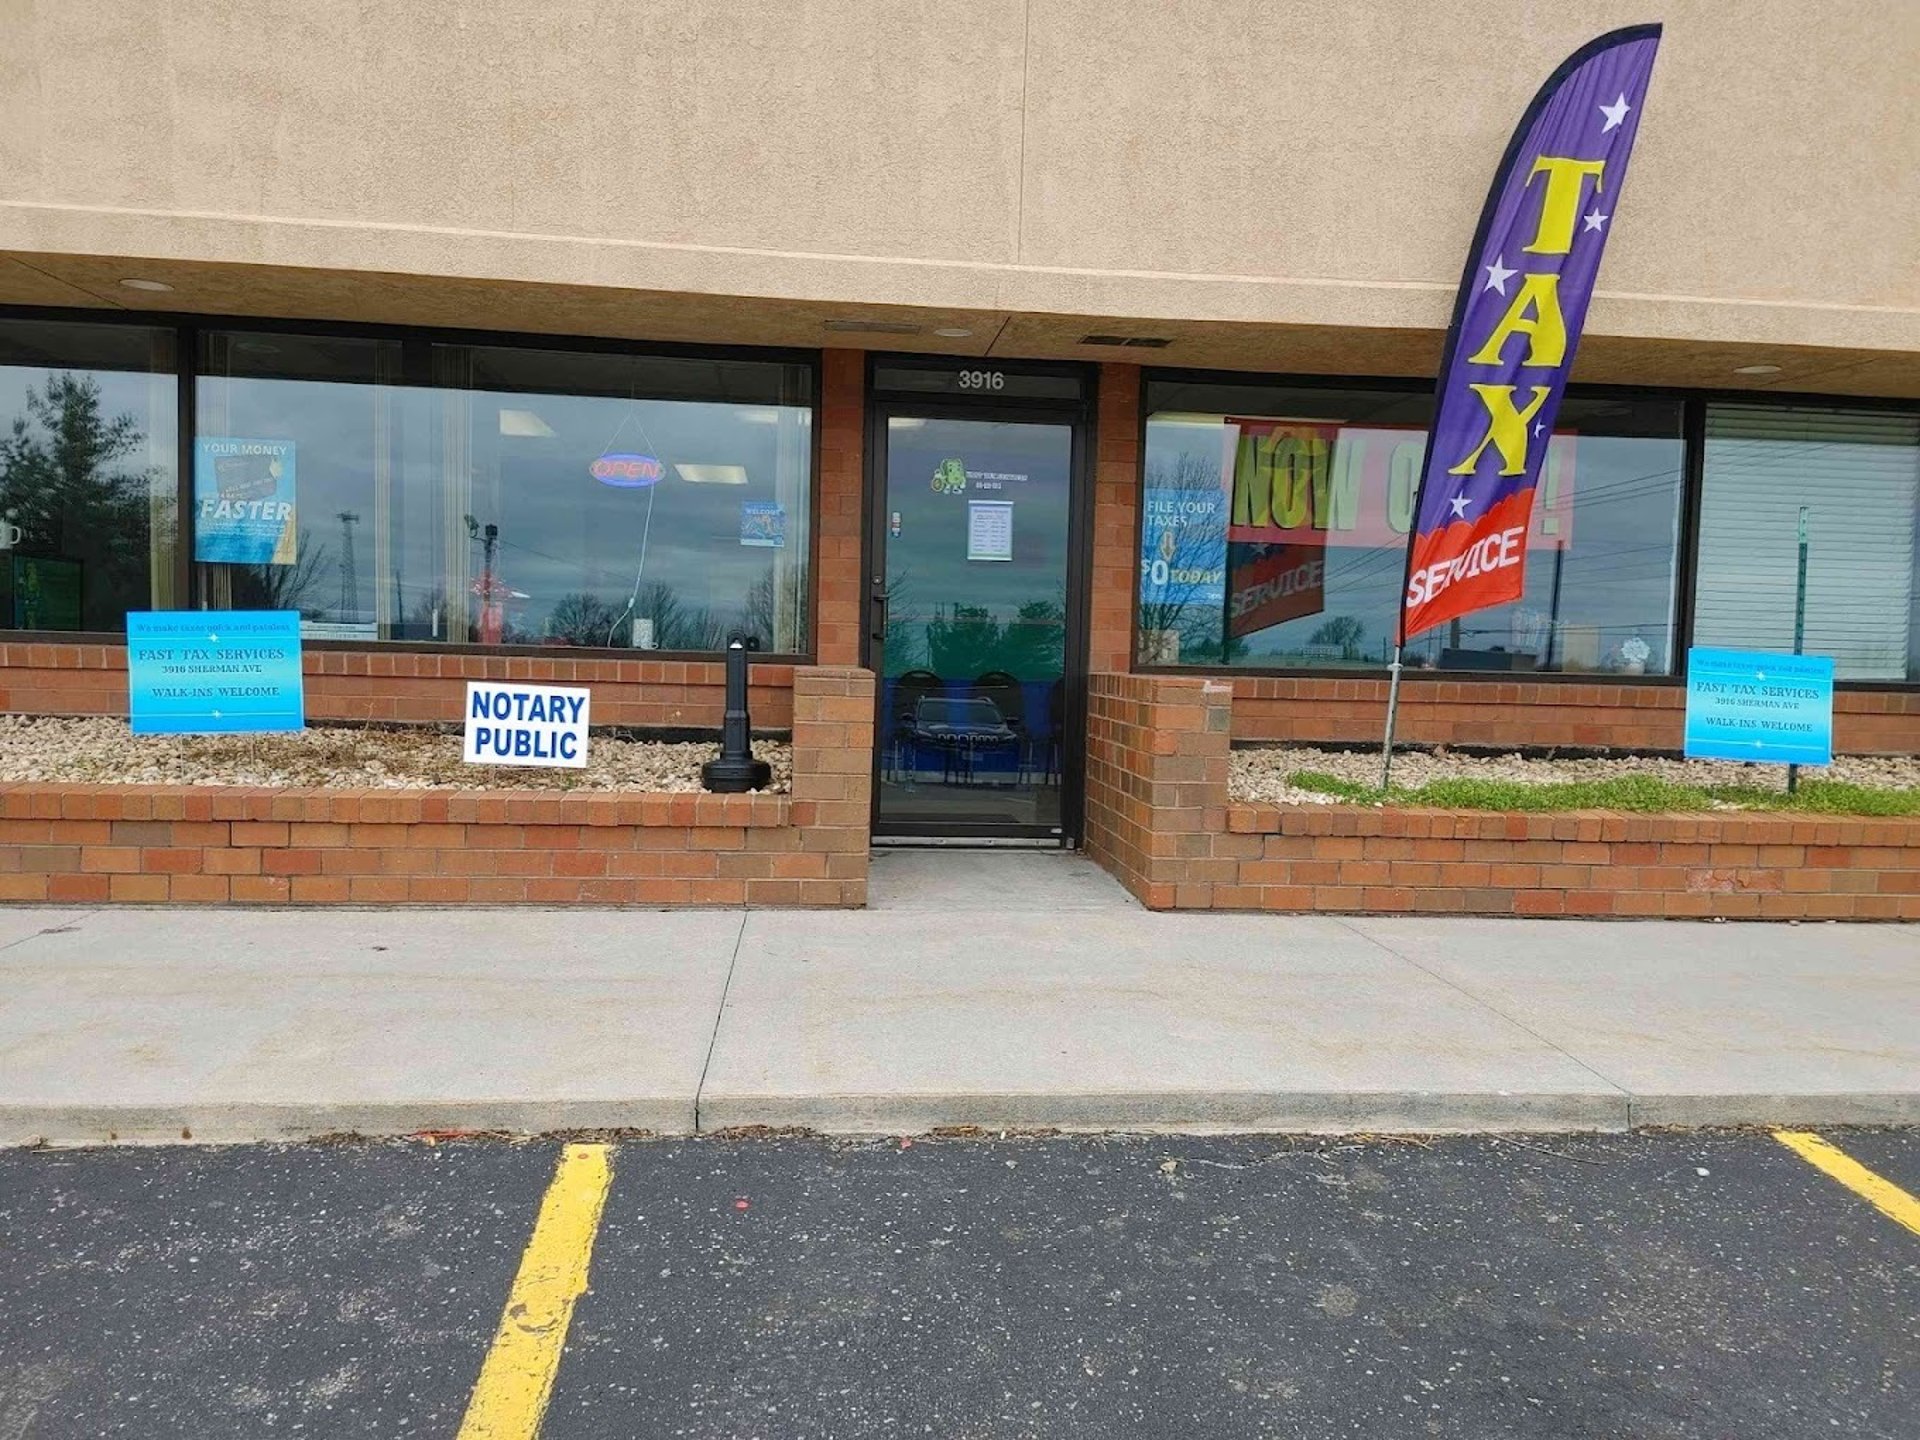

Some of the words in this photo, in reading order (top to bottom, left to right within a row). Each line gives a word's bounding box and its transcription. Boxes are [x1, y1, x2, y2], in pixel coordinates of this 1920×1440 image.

[1448, 155, 1606, 476] TAX
[958, 370, 1005, 390] 3916
[203, 443, 238, 454] YOUR
[241, 444, 288, 456] MONEY
[592, 460, 660, 478] OPEN
[1231, 434, 1367, 531] NOW
[201, 499, 292, 521] FASTER
[1147, 500, 1174, 514] FILE
[1179, 501, 1216, 514] YOUR
[1147, 515, 1188, 527] TAXES
[1170, 569, 1223, 585] TODAY
[139, 650, 175, 661] FAST
[182, 649, 210, 660] TAX
[216, 649, 285, 660] SERVICES
[162, 665, 186, 674] 3916
[188, 665, 240, 673] SHERMAN
[240, 664, 262, 673] AVE
[152, 687, 213, 698] WALK-INS
[218, 687, 281, 697] WELCOME
[1696, 681, 1727, 693] FAST
[1731, 684, 1757, 695] TAX
[1761, 685, 1820, 700] SERVICES
[472, 690, 586, 724] NOTARY
[1715, 697, 1736, 705] 3916
[1736, 698, 1782, 709] SHERMAN
[1781, 701, 1800, 710] AVE
[1705, 717, 1757, 728] WALK-INS
[1761, 720, 1813, 732] WELCOME
[475, 727, 578, 760] PUBLIC
